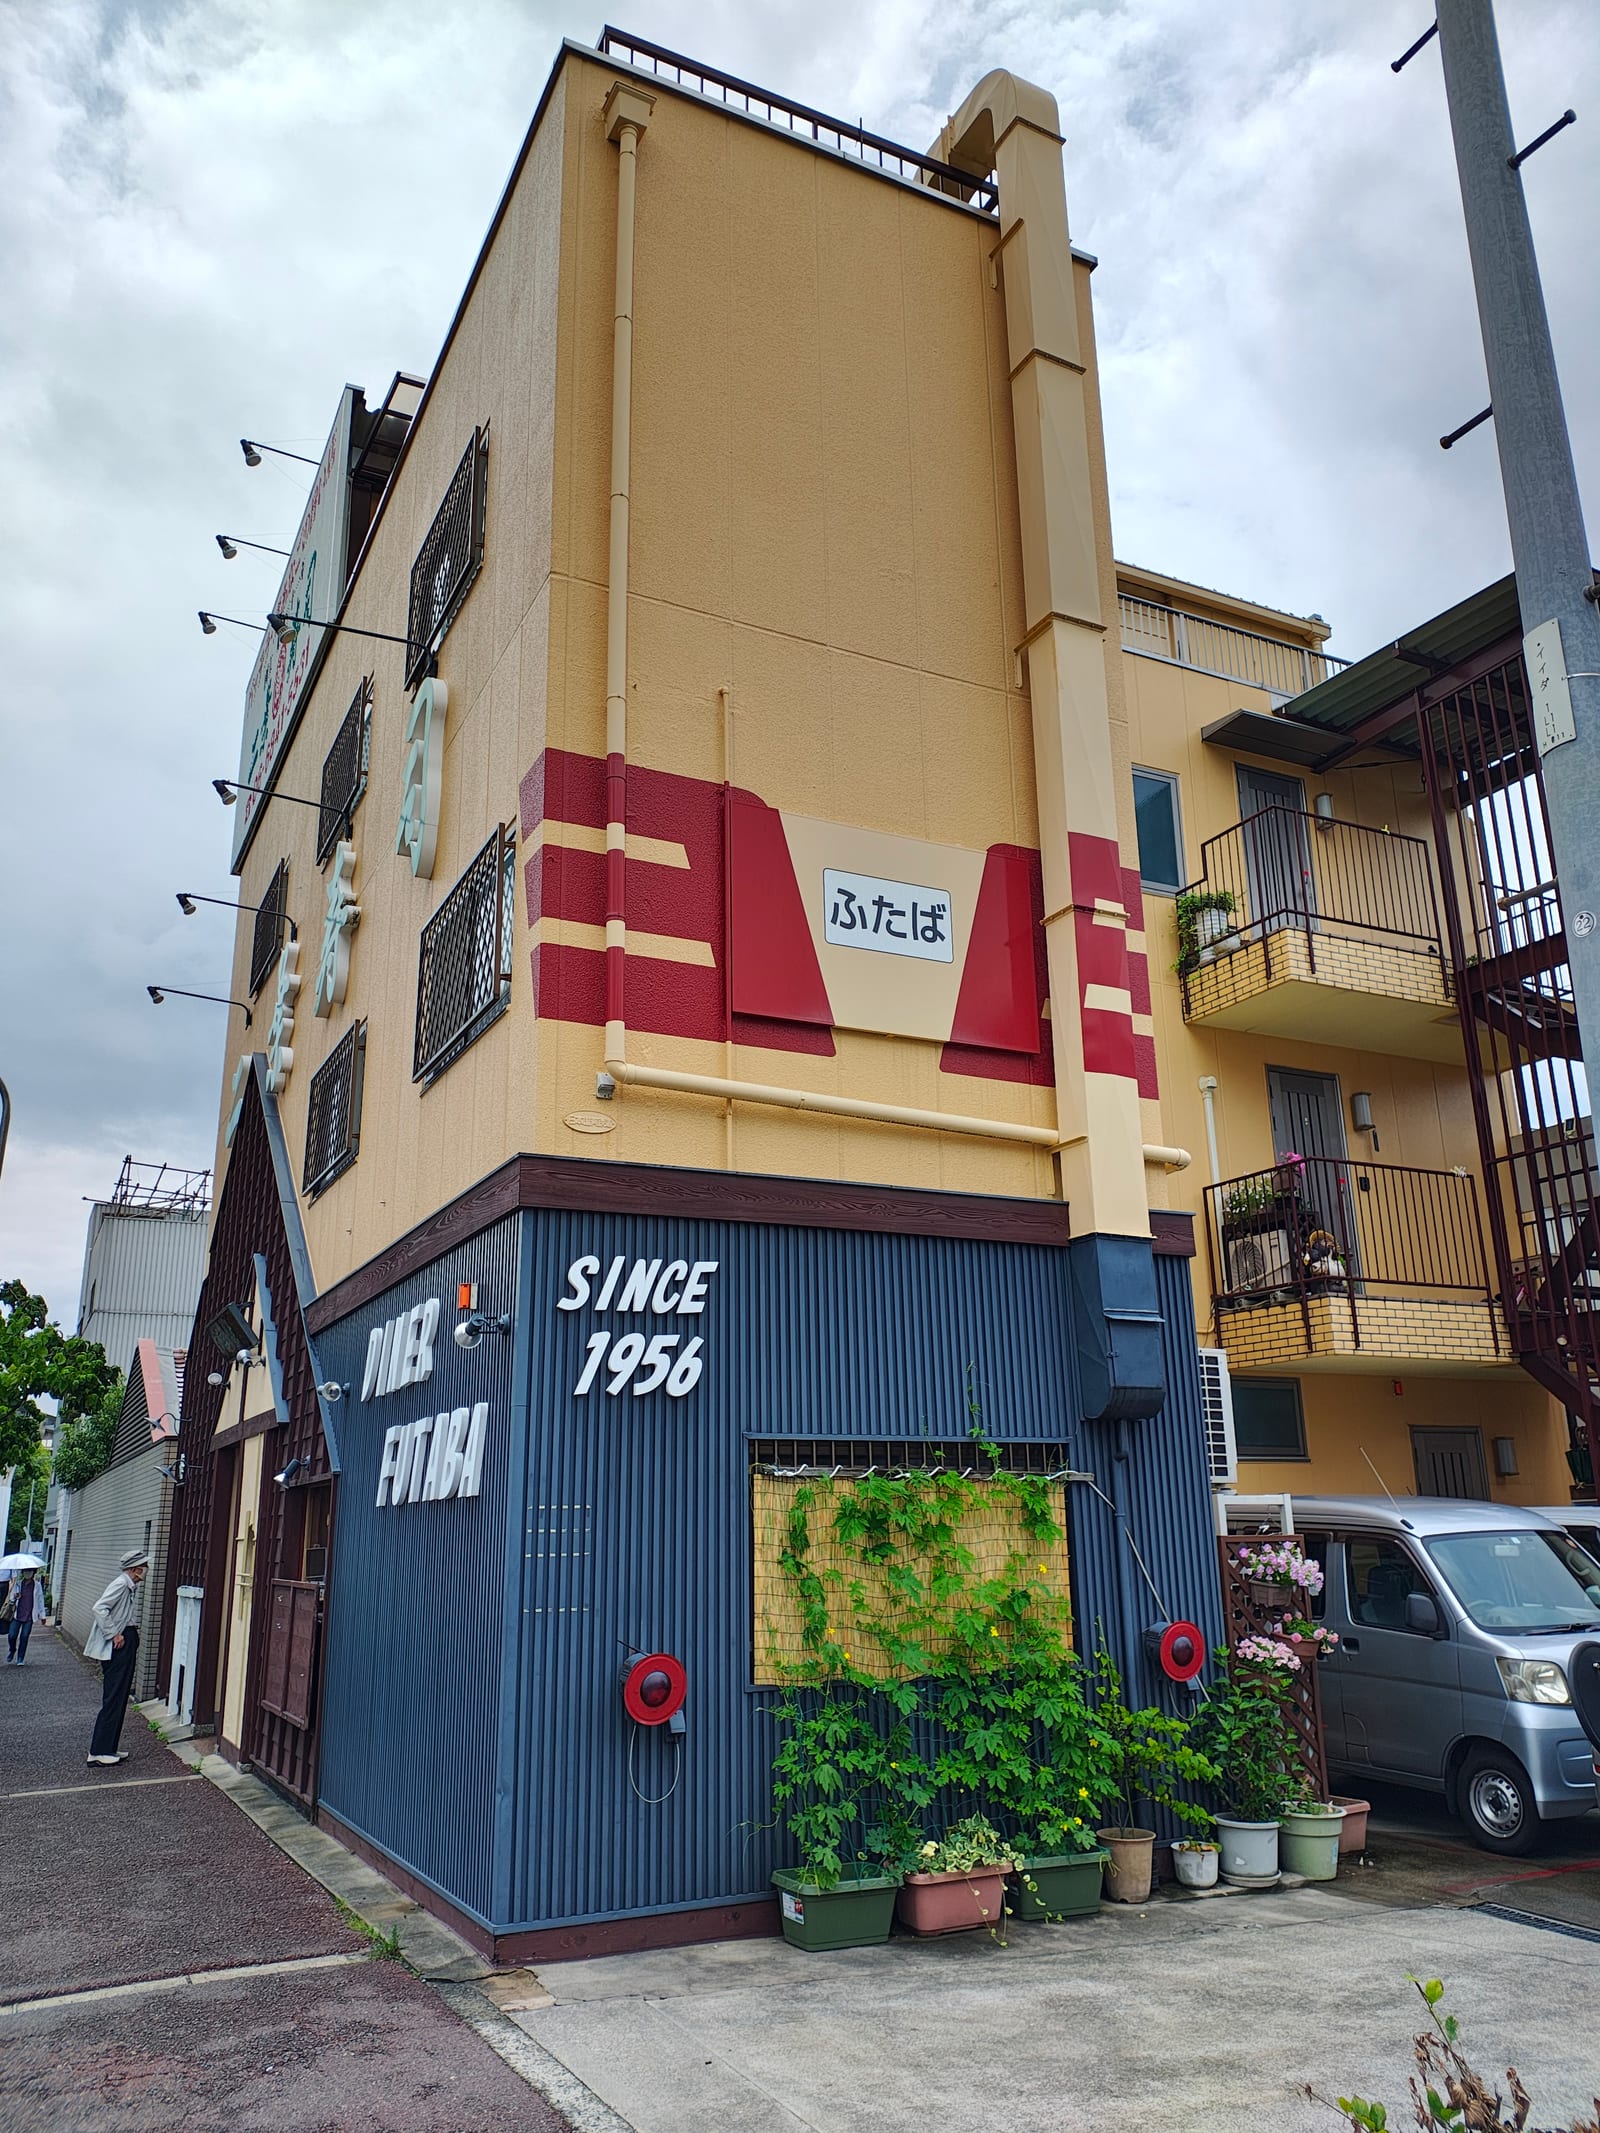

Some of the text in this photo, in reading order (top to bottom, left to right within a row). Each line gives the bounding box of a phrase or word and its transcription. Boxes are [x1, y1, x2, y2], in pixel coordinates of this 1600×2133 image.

[830, 888, 946, 944] ふたば
[1576, 917, 1591, 931] 22
[557, 1255, 719, 1315] SINCE
[361, 1298, 440, 1402] DINER
[573, 1331, 704, 1397] 1956
[376, 1402, 489, 1507] FUTABA
